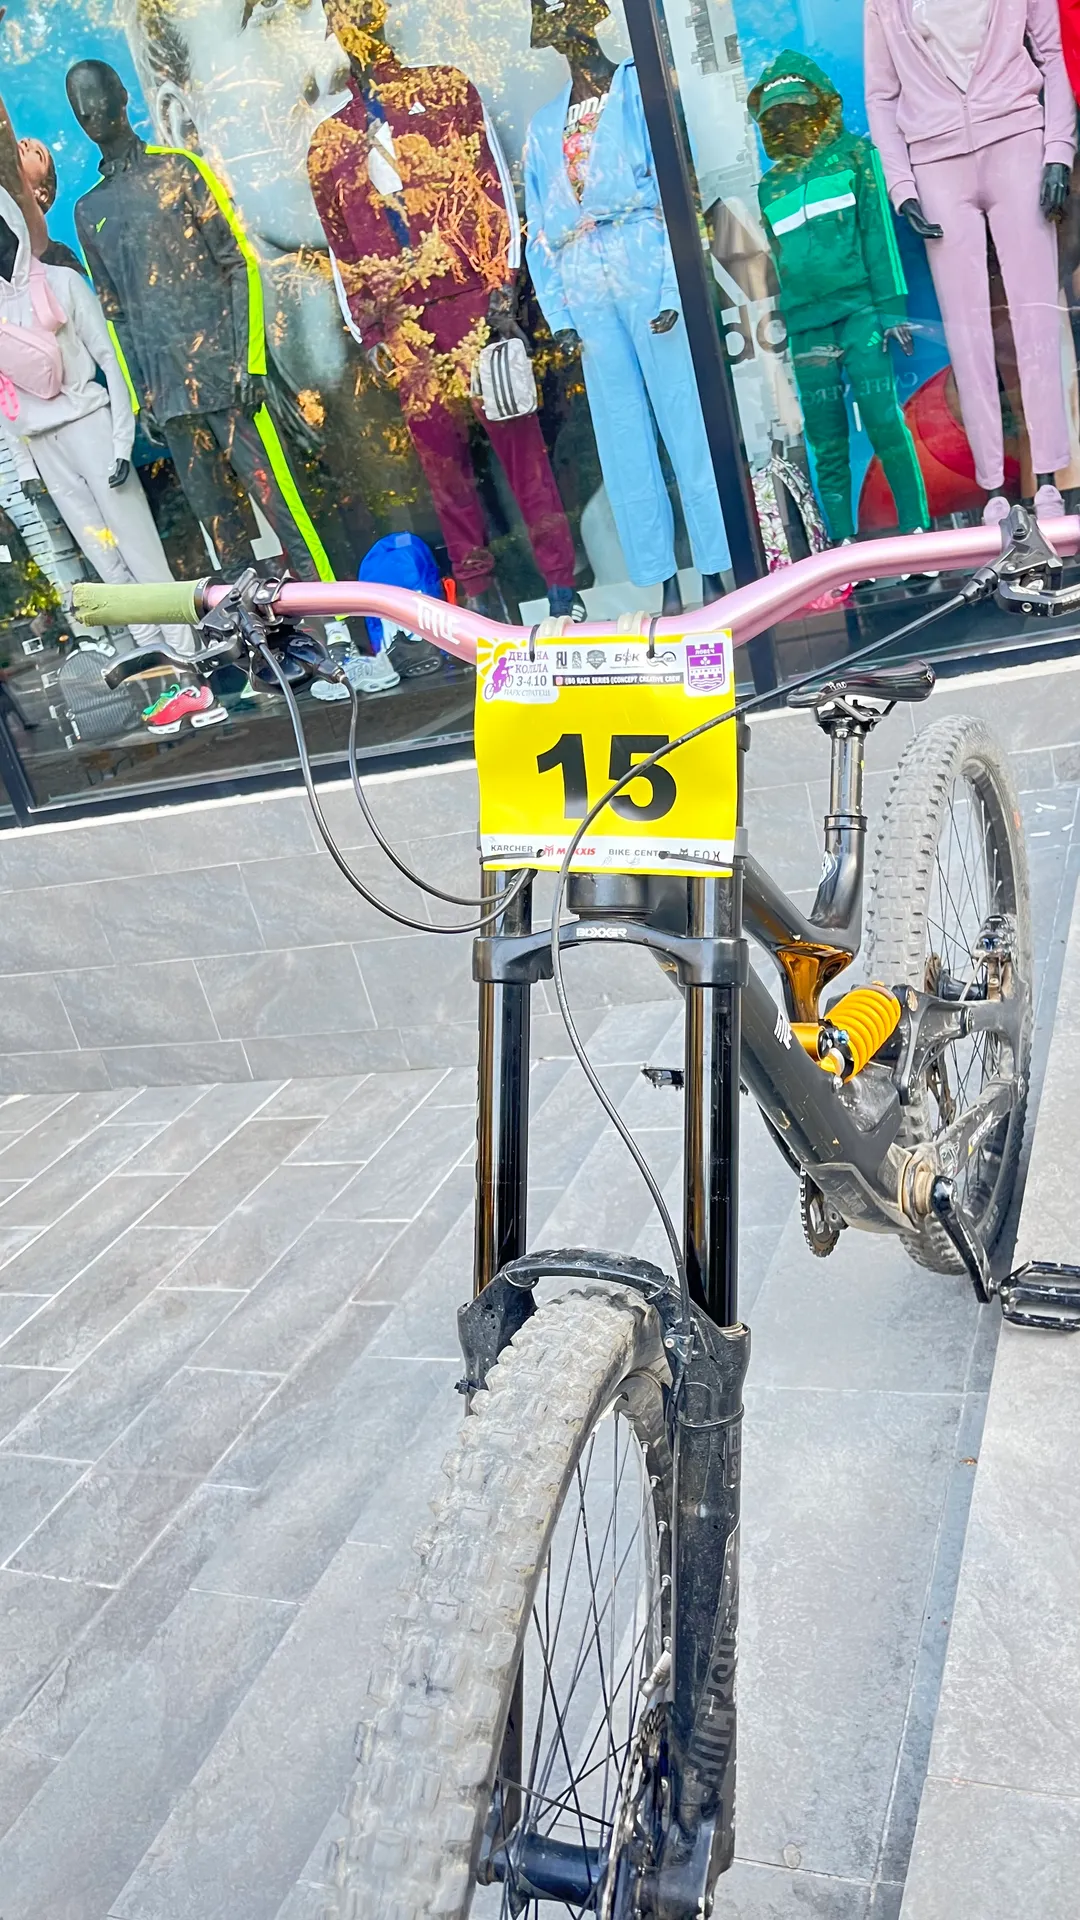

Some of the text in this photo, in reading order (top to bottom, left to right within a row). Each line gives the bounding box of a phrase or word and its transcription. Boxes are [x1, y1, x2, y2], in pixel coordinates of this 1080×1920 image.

[516, 674, 547, 687] 3-4.10
[536, 733, 677, 822] 15
[556, 847, 596, 856] MXXIS
[608, 848, 630, 856] BIKE
